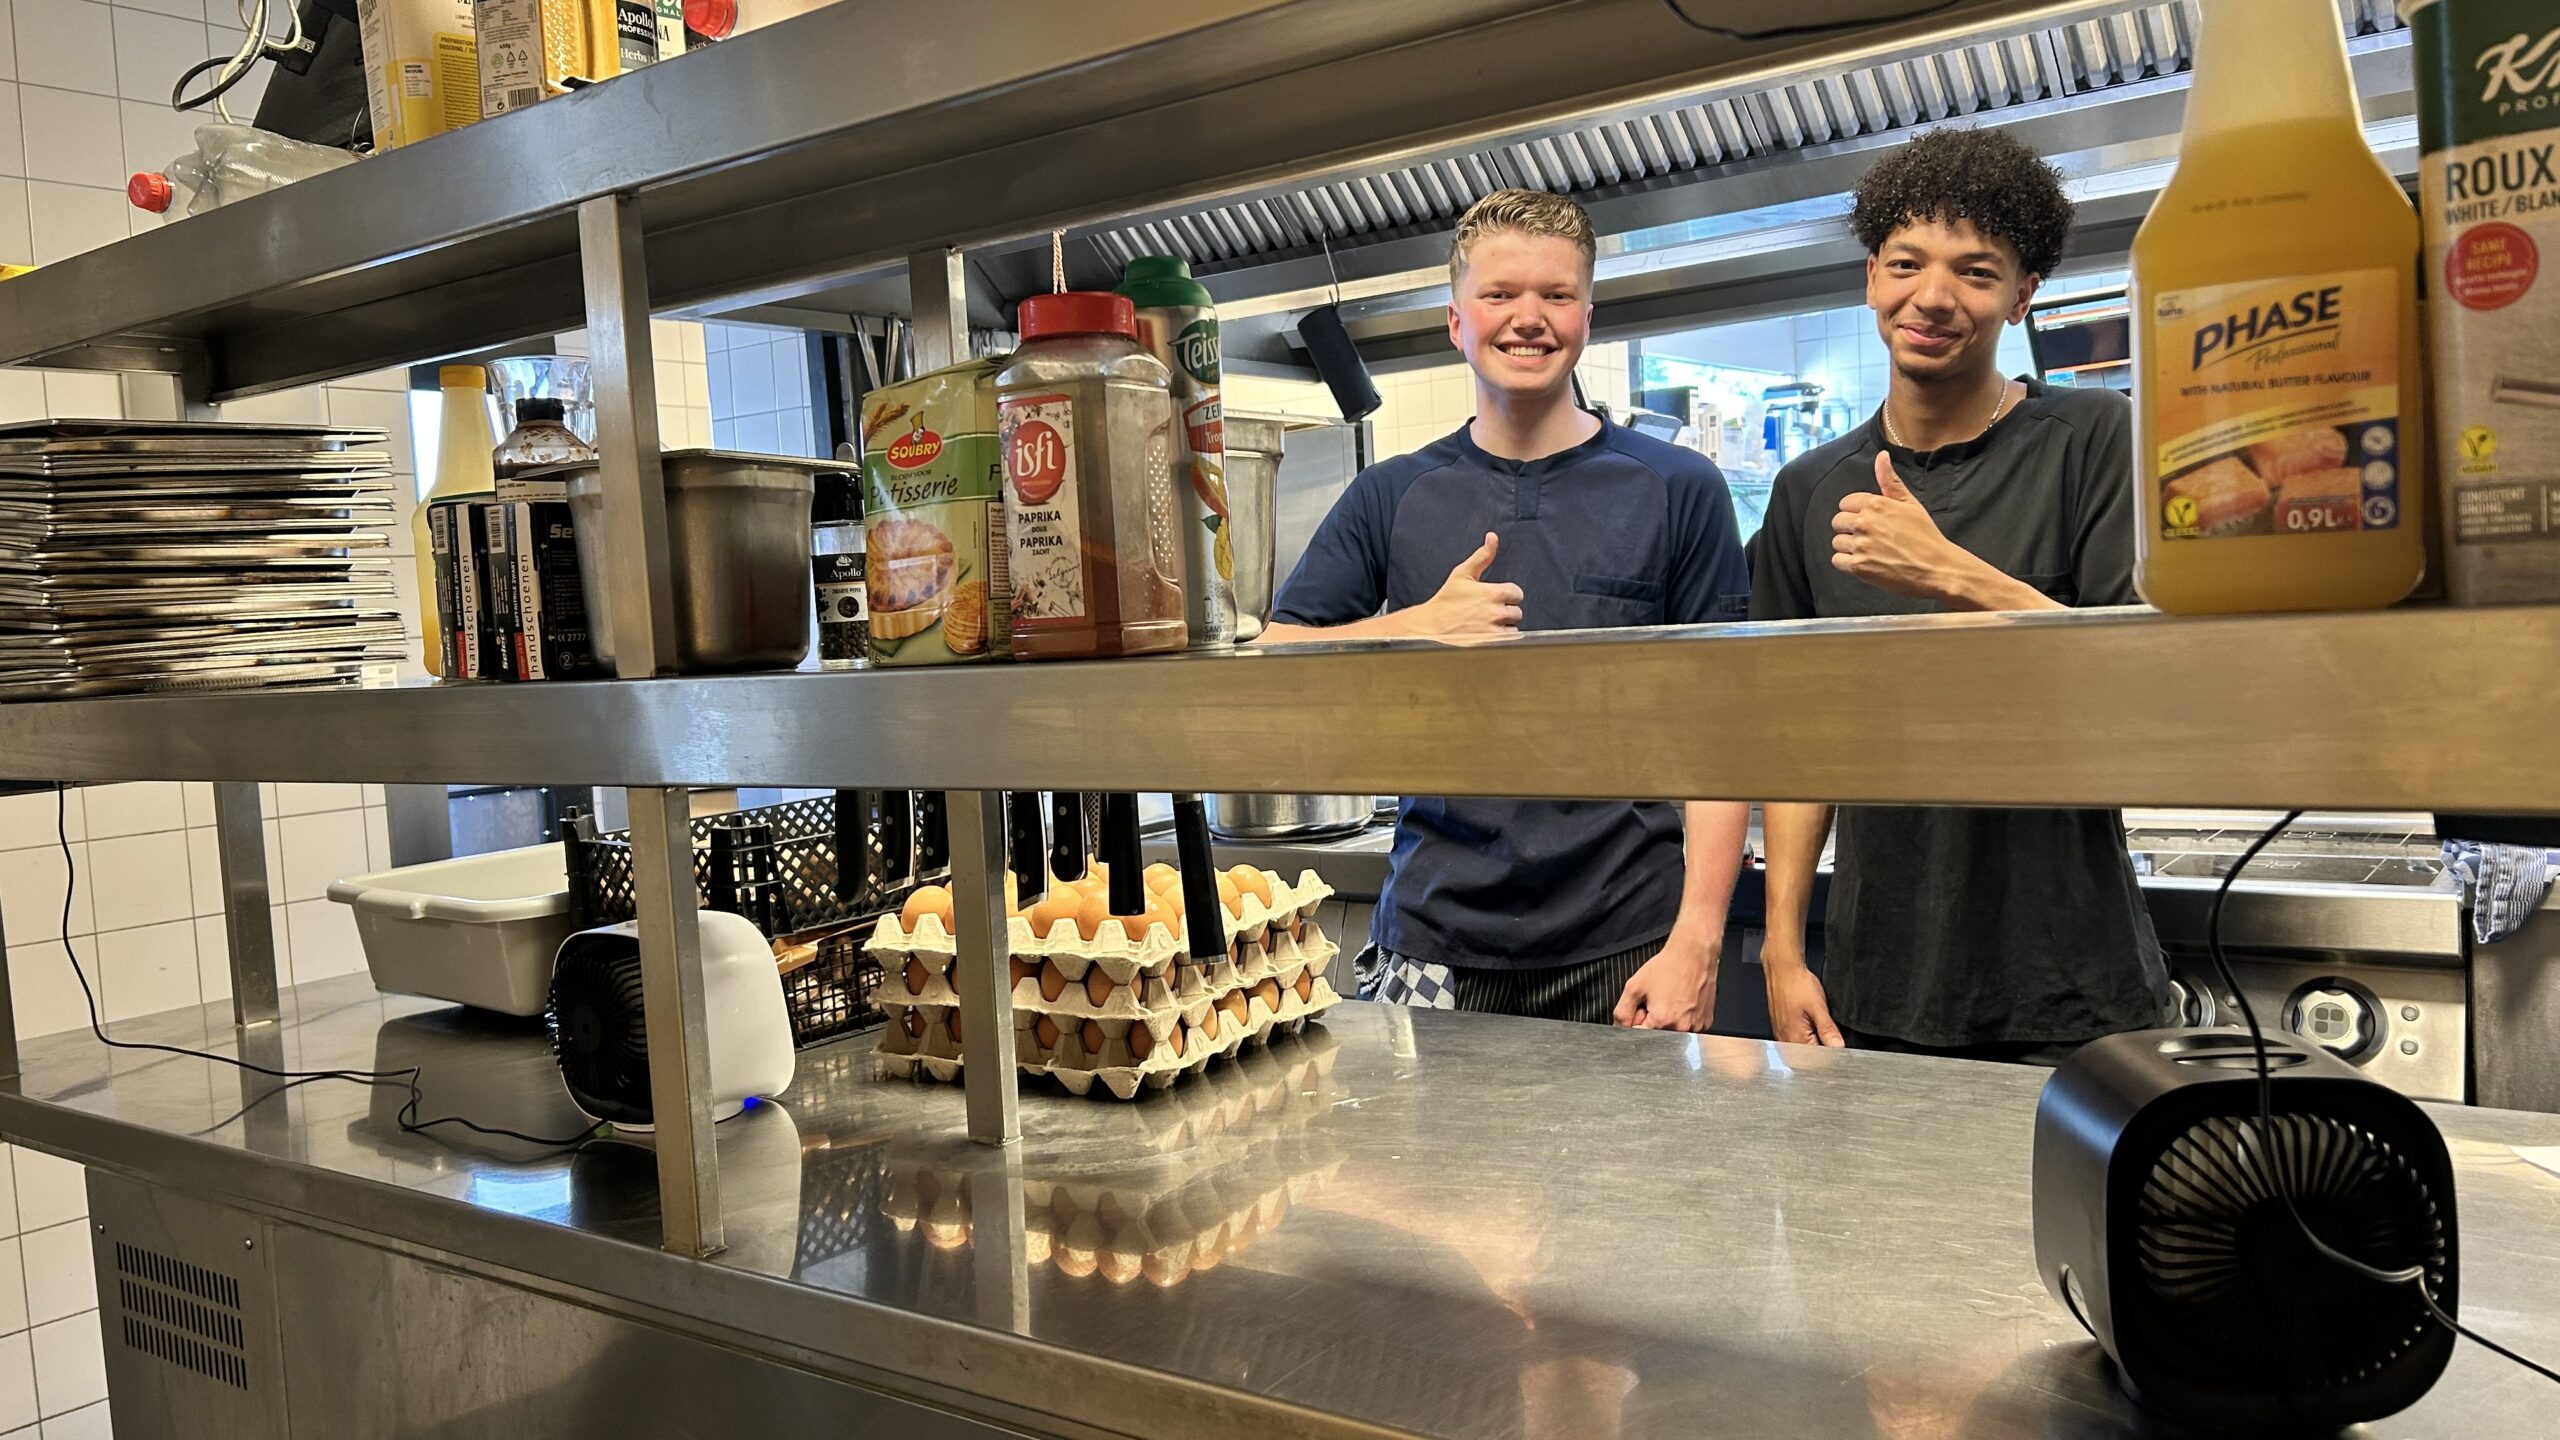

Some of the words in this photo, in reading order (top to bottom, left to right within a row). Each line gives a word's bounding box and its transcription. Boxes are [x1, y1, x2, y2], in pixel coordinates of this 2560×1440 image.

[618, 7, 653, 28] Apollo
[620, 47, 648, 63] Herbs
[2445, 144, 2555, 202] ROUX
[2192, 286, 2342, 371] PHASE
[890, 441, 941, 460] SOUBRY
[1015, 430, 1057, 478] isfi
[1018, 510, 1062, 524] PAPRIKA
[1020, 535, 1063, 549] PAPRIKA
[1032, 548, 1051, 556] ZACHT
[830, 567, 863, 580] Apollo
[460, 554, 478, 672] handschoenen
[520, 554, 539, 673] handschoenen
[567, 633, 587, 642] 2777
